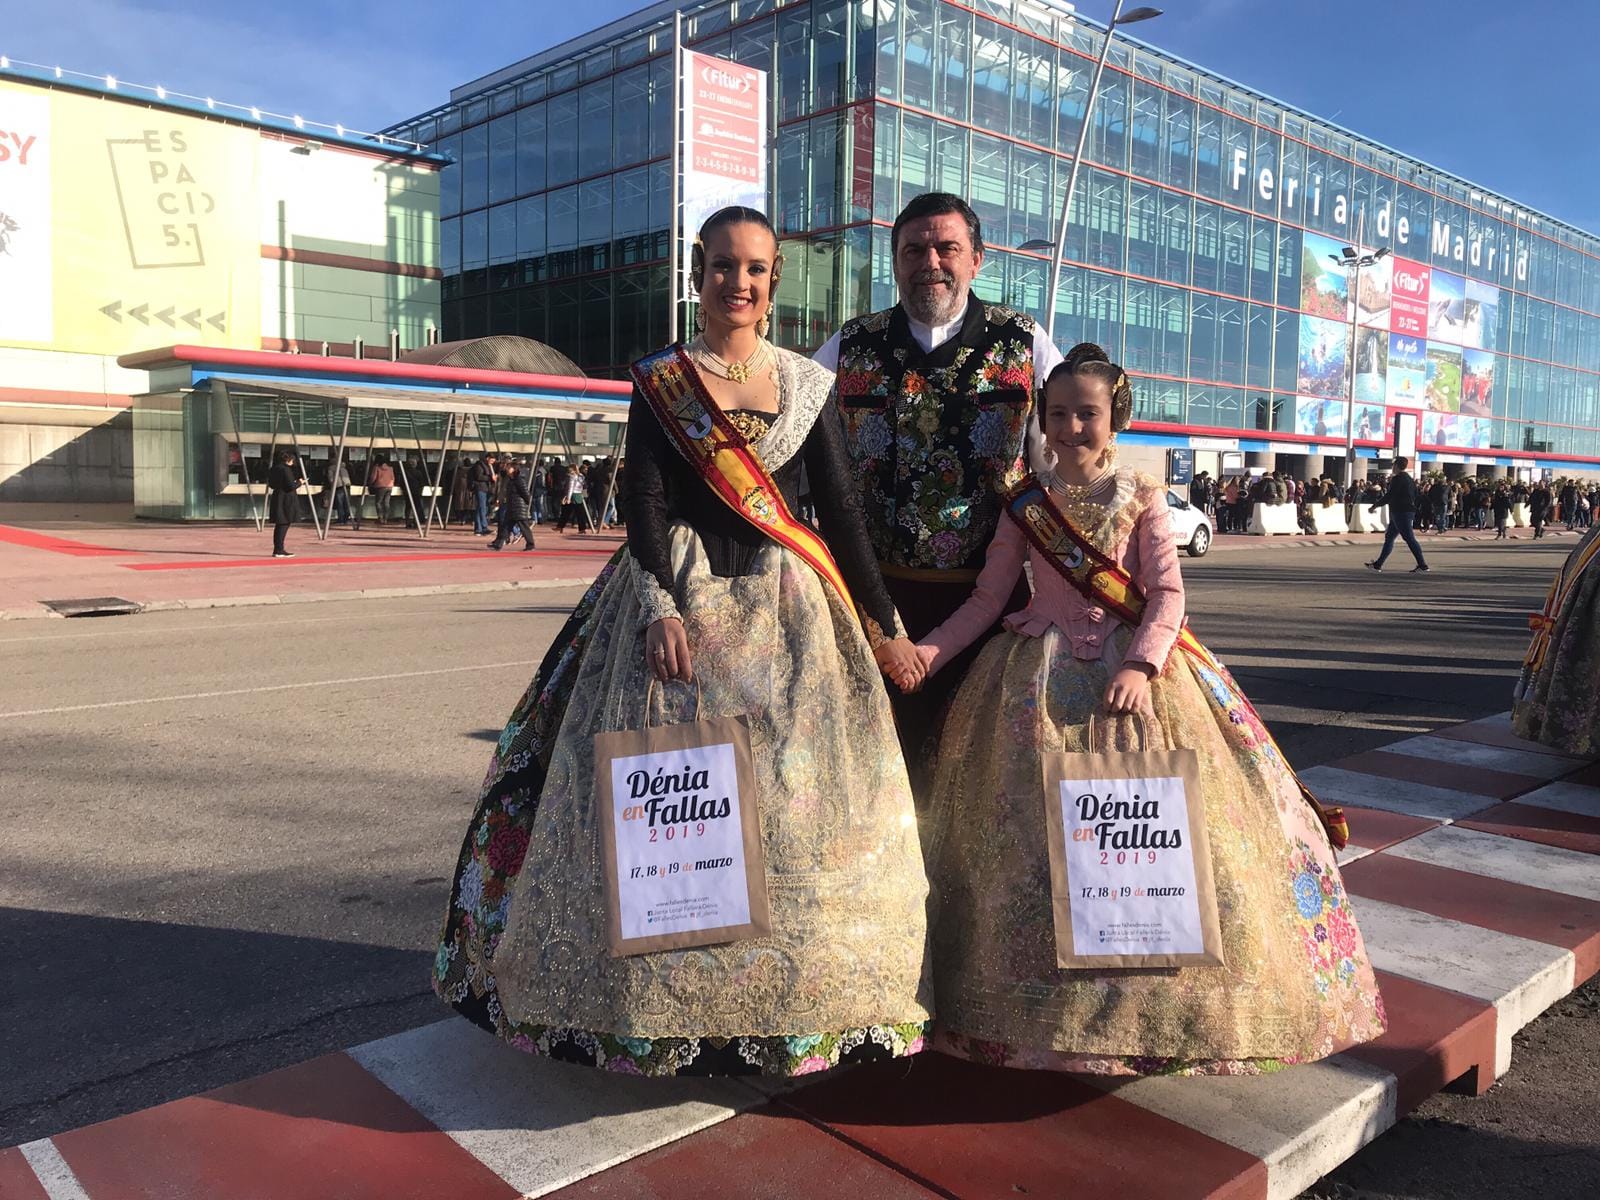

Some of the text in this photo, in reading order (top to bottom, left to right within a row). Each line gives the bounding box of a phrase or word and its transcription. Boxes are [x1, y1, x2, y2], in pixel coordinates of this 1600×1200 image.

[142, 129, 188, 153] ES
[149, 160, 197, 184] PA
[1233, 148, 1529, 281] Feria de Madrid
[626, 765, 709, 799] Dénia
[622, 795, 731, 827] en Fallas
[1075, 793, 1160, 821] Dénia
[649, 822, 705, 843] 2019
[1072, 822, 1182, 850] en Fallas
[646, 865, 658, 877] 18
[659, 866, 666, 879] y
[668, 862, 680, 874] 19
[682, 862, 693, 872] de
[694, 857, 733, 871] marzo
[1100, 851, 1156, 865] 2019
[1098, 886, 1109, 898] 18
[1111, 889, 1118, 901] y
[1120, 886, 1131, 897] 19
[1134, 888, 1146, 897] de
[1147, 886, 1185, 897] marzo
